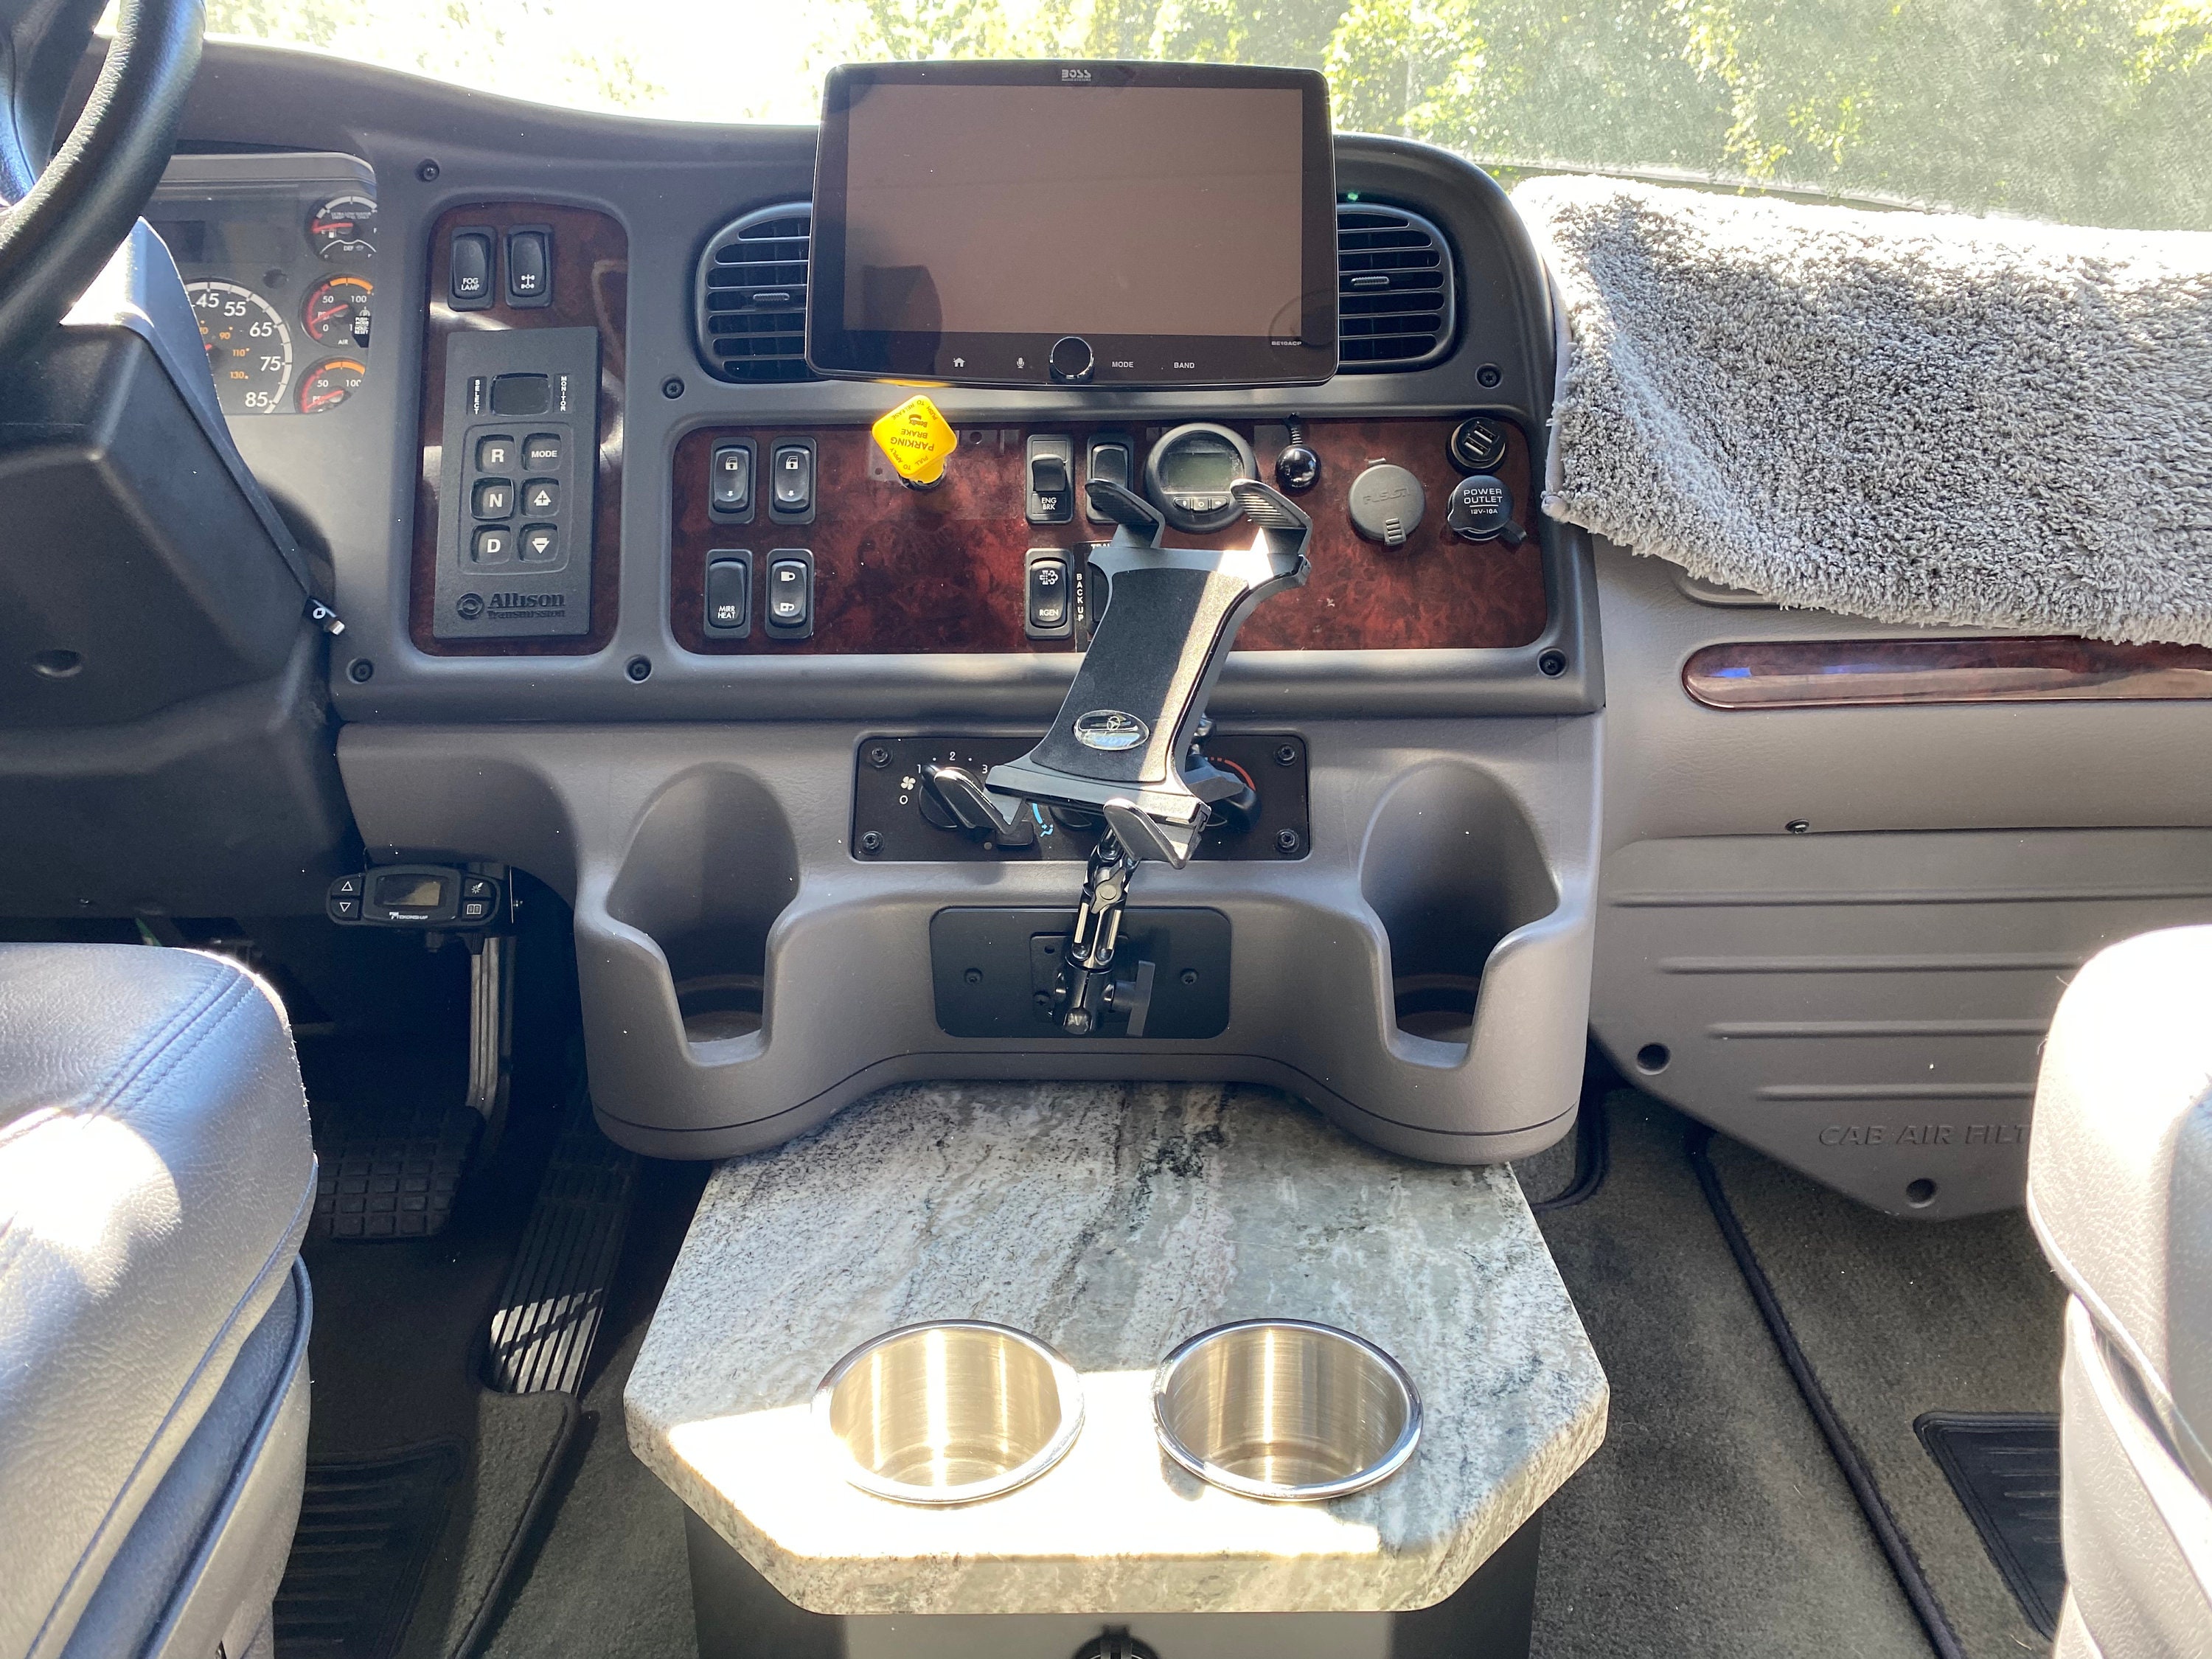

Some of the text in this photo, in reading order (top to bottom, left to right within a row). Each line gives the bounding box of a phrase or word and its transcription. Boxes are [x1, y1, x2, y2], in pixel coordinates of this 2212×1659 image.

[1062, 69, 1091, 78] BOSS
[196, 293, 220, 307] 45
[223, 302, 246, 316] 55
[249, 321, 272, 337] 65
[260, 356, 281, 372] 75
[245, 392, 268, 407] 85
[891, 403, 914, 420] RELEASE
[927, 406, 939, 420] PUSH
[900, 428, 928, 439] BRAKE
[890, 437, 934, 451] PARKING
[491, 449, 504, 462] R
[890, 448, 903, 463] APPLY
[915, 456, 928, 466] PULL
[1464, 488, 1502, 496] POWER
[489, 494, 503, 507] N
[1464, 495, 1503, 504] OUTLET
[487, 539, 501, 553] D
[488, 593, 566, 608] Allison
[1077, 606, 1084, 622] UP
[949, 751, 956, 761] 2
[917, 764, 921, 773] 1
[981, 764, 988, 773] 3
[1818, 1124, 1887, 1146] CAB
[1896, 1124, 1953, 1145] AIR
